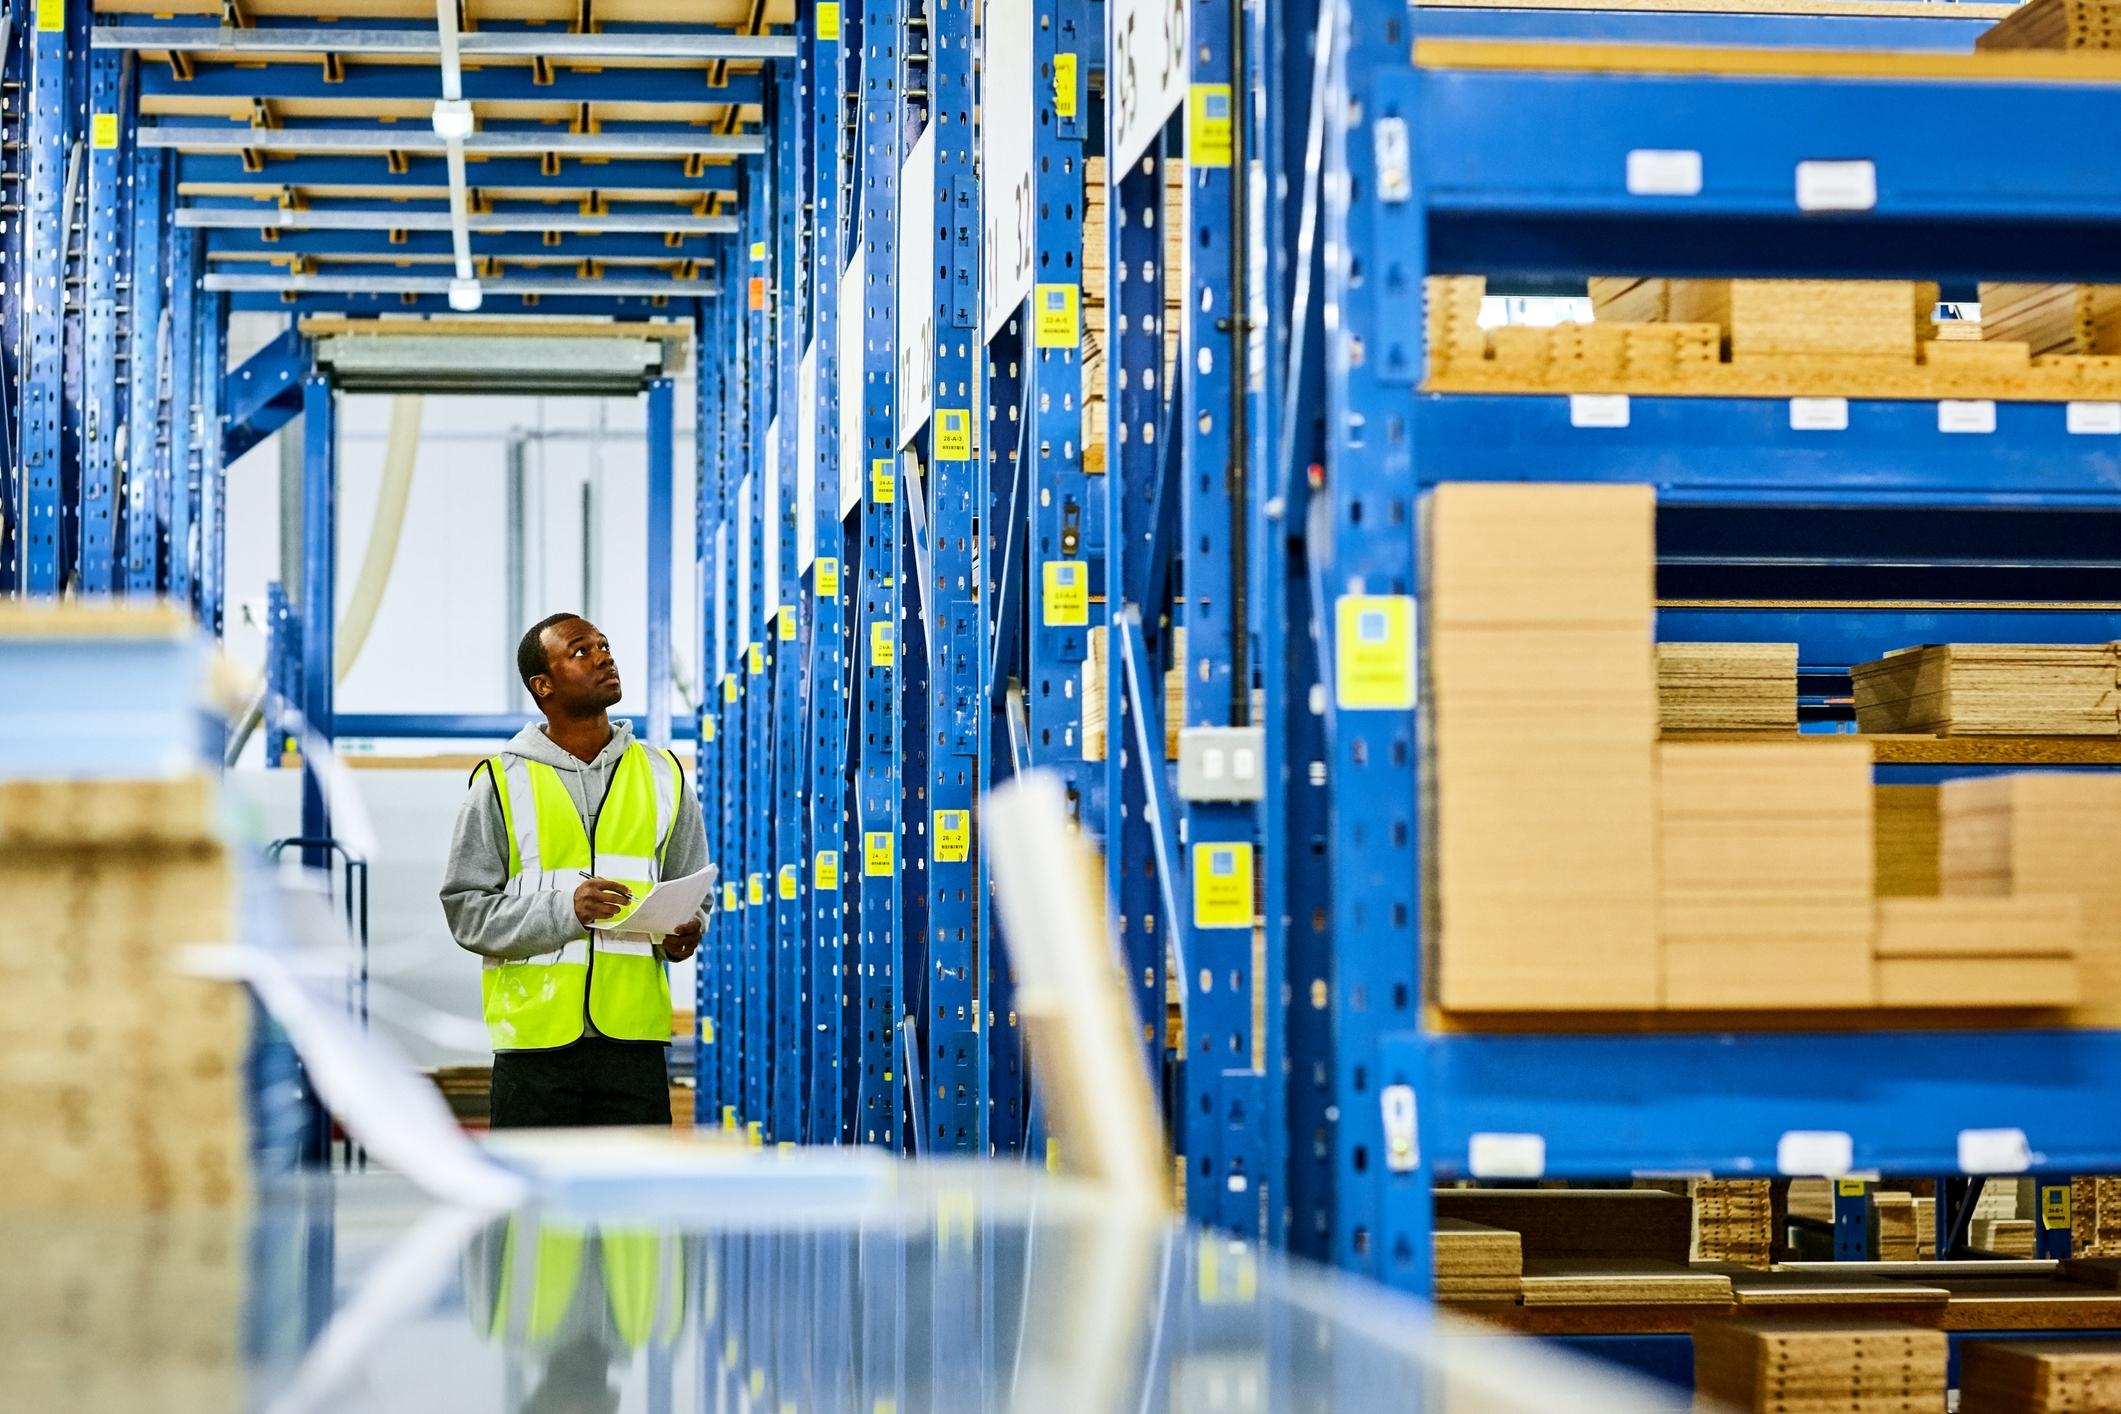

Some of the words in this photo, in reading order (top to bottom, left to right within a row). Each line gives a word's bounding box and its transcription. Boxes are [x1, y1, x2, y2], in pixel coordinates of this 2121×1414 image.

[1117, 9, 1137, 146] 35
[1015, 170, 1031, 282] 32
[920, 315, 932, 404] 28
